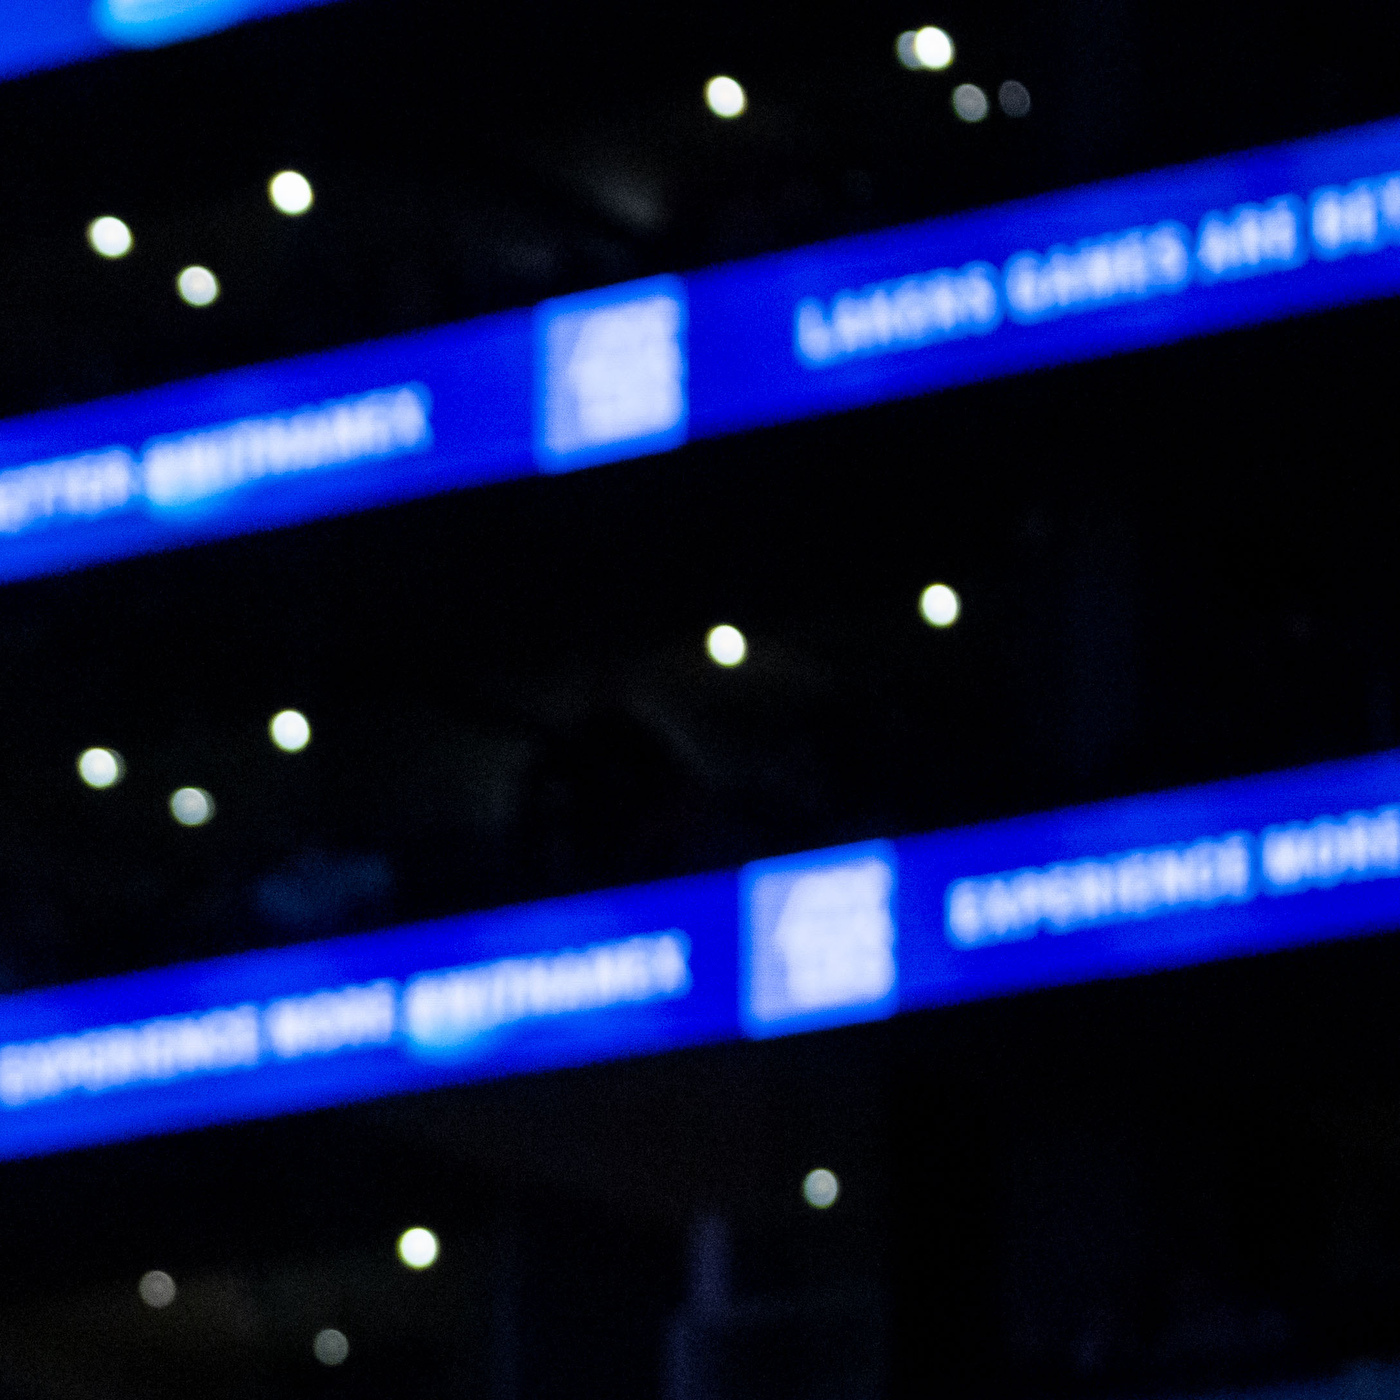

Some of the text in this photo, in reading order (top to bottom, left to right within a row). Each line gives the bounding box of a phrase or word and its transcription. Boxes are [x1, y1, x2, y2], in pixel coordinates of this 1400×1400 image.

[801, 275, 993, 356] LAKERS
[1010, 232, 1184, 310] GAMES
[1202, 209, 1294, 270] ARE
[952, 840, 1247, 938] EXPERIENCE
